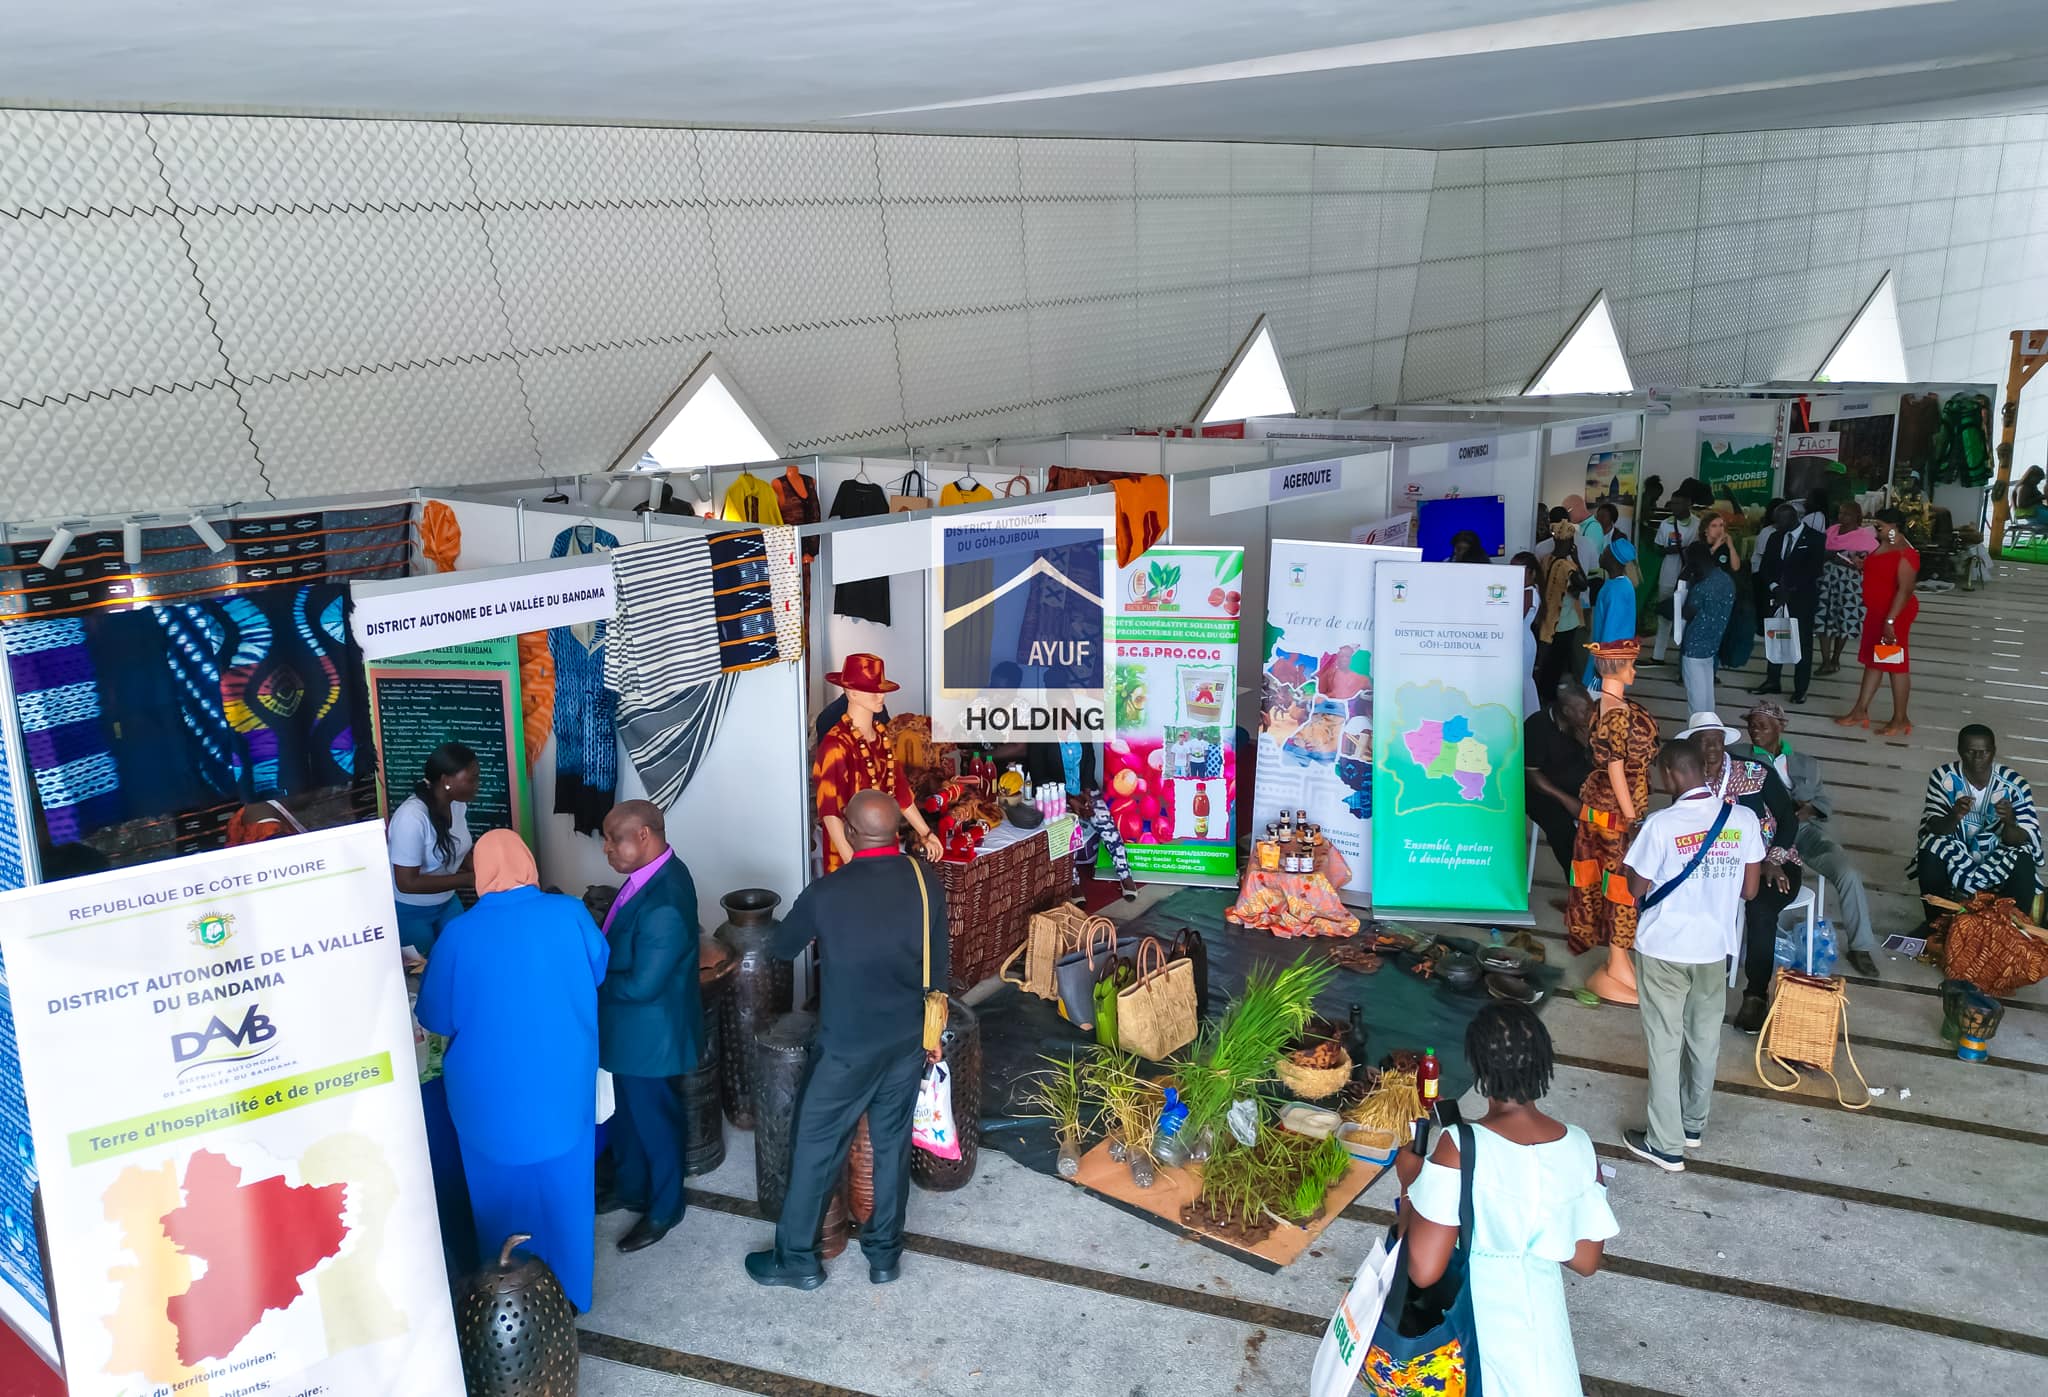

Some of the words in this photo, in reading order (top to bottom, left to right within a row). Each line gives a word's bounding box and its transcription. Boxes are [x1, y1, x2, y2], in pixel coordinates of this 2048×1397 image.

[1458, 444, 1488, 460] CONFINSCI
[1282, 468, 1331, 490] AGEROUTE
[1726, 471, 1768, 482] POUDRES
[946, 522, 993, 538] DISTRICT
[995, 514, 1048, 530] AUTONOME
[958, 540, 972, 552] DU
[366, 617, 416, 636] DISTRICT
[420, 608, 477, 628] AUTONOME
[480, 606, 492, 617] DE
[495, 604, 508, 614] LA
[510, 594, 544, 612] VALLÉE
[547, 594, 560, 606] DU
[562, 587, 606, 604] BANDAMA
[1287, 612, 1322, 628] Terre
[1326, 616, 1342, 628] de
[1394, 628, 1435, 638] DISTRICT
[1436, 631, 1488, 640] AUTONOME
[1491, 632, 1504, 640] DU
[1676, 836, 1692, 846] SCS
[1678, 846, 1700, 855] SUPER
[1420, 852, 1492, 870] développement
[69, 888, 178, 921] REPUBLIQUE
[182, 884, 205, 898] DE
[208, 873, 253, 893] CÔTE
[257, 858, 327, 884] D'IVOIRE
[47, 982, 140, 1015] DISTRICT
[145, 956, 256, 994] AUTONOME
[260, 948, 286, 966] DE
[291, 943, 314, 960] LA
[318, 926, 384, 953] VALLÉE
[153, 996, 180, 1014] DU
[187, 972, 285, 1006] BANDAMA
[171, 1004, 277, 1062] DAVB
[227, 1056, 280, 1073] AUTONOME
[250, 1060, 298, 1076] BANDAMA
[90, 1132, 138, 1151] Terre
[144, 1096, 260, 1138] d'hospitalité
[264, 1091, 283, 1106] et
[287, 1082, 309, 1100] de
[314, 1065, 380, 1094] progrès
[153, 1388, 168, 1397] du
[172, 1366, 226, 1392] territoire
[230, 1351, 276, 1373] ivoirien;
